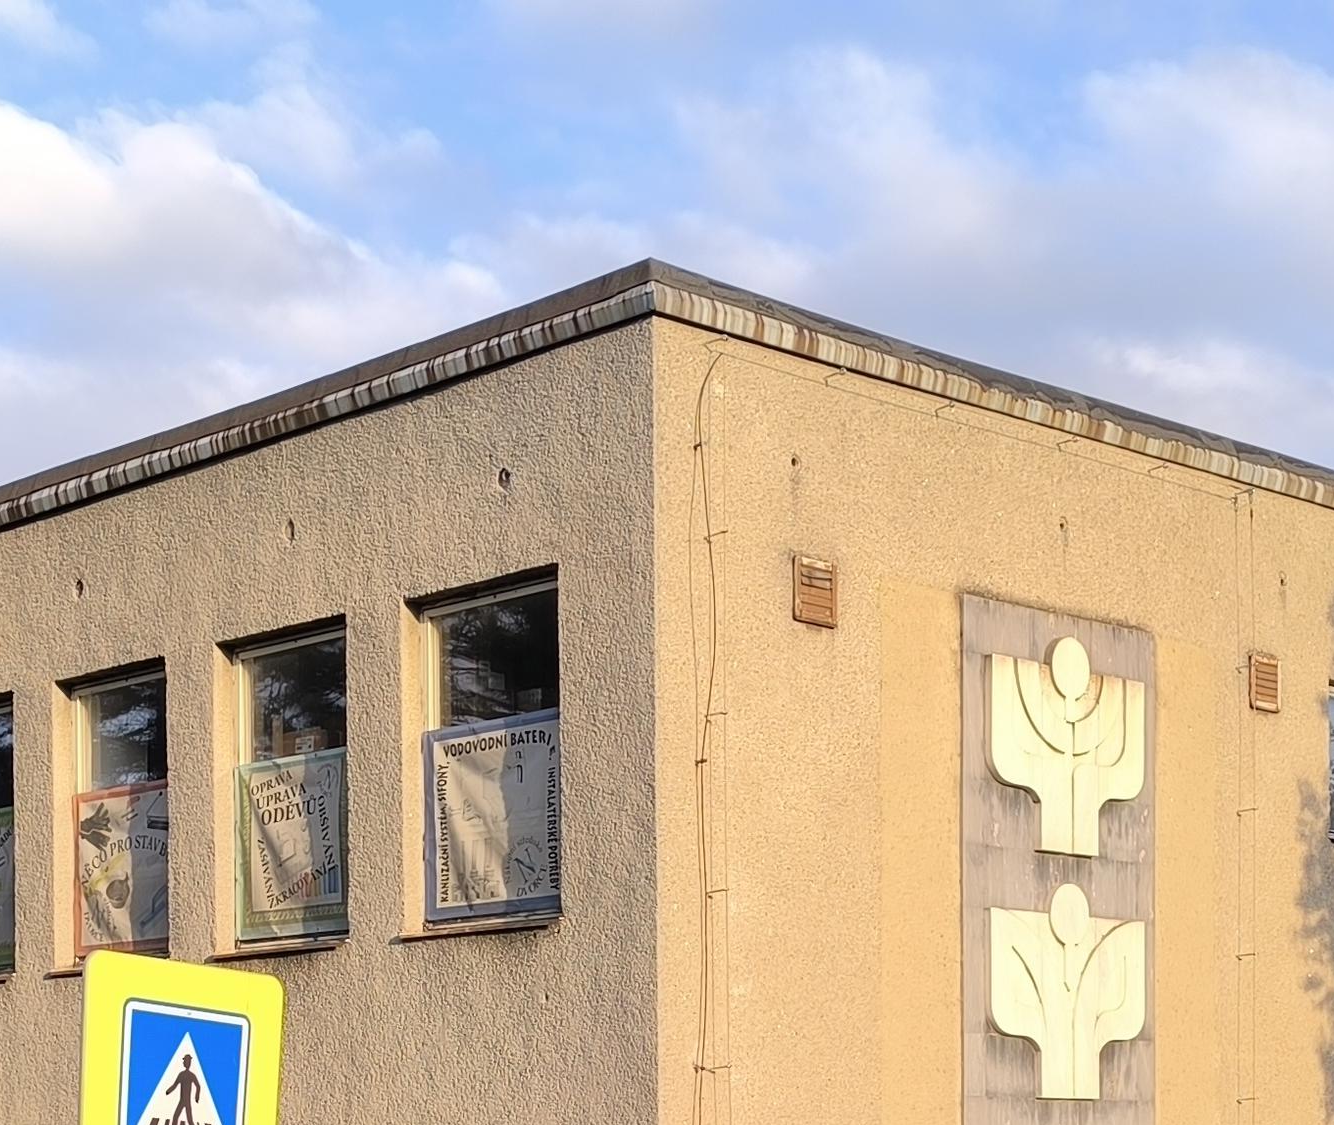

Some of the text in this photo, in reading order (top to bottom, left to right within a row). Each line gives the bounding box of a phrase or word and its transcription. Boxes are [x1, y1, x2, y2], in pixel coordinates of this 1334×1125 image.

[443, 729, 508, 758] VODOVODNÍ
[251, 770, 293, 796] OPRAVA
[261, 794, 318, 826] ODĚVŮ
[109, 836, 133, 857] PRO
[134, 835, 168, 864] STAVB
